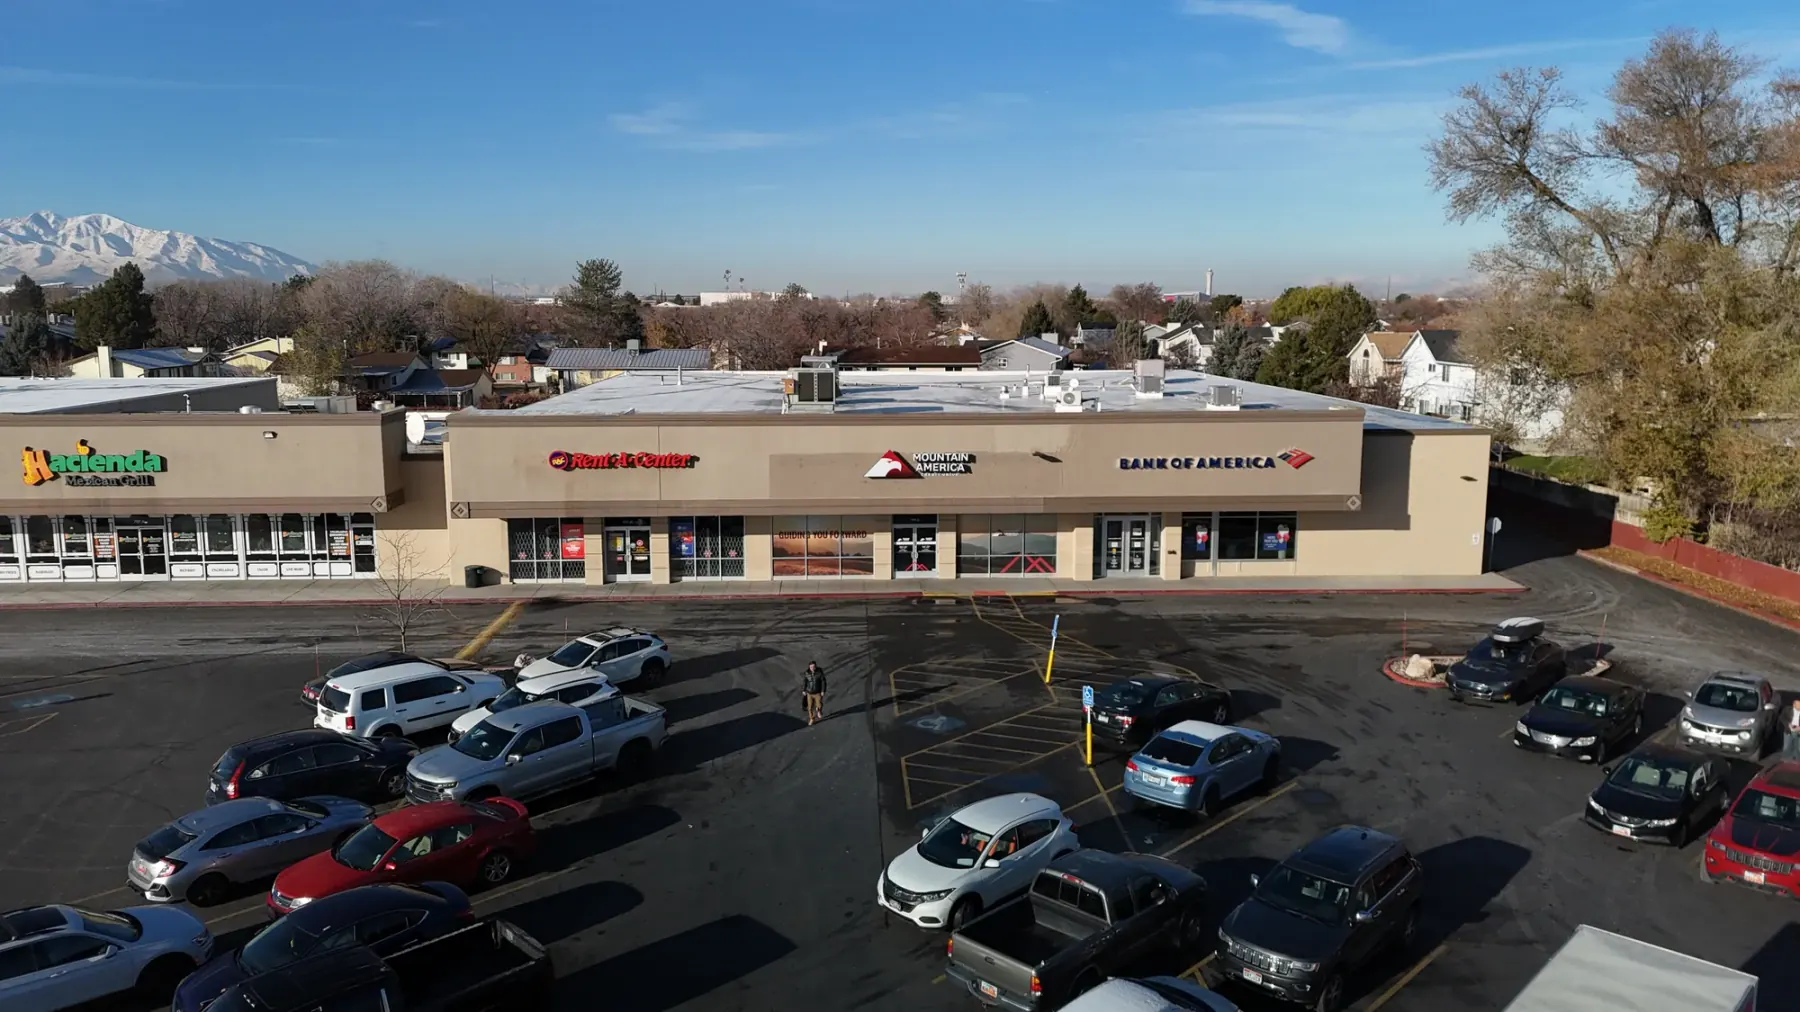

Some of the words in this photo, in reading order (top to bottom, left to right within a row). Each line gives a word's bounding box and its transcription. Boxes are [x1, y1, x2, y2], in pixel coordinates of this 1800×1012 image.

[21, 440, 162, 485] Hacienda
[912, 453, 969, 463] MOUNTAIN
[1119, 457, 1168, 470] BANK
[1170, 457, 1194, 469] OF
[1196, 456, 1276, 469] AMERICA
[915, 463, 966, 472] AMERICA
[65, 475, 118, 486] Mexican
[120, 475, 151, 486] Grill
[813, 530, 828, 539] YOU
